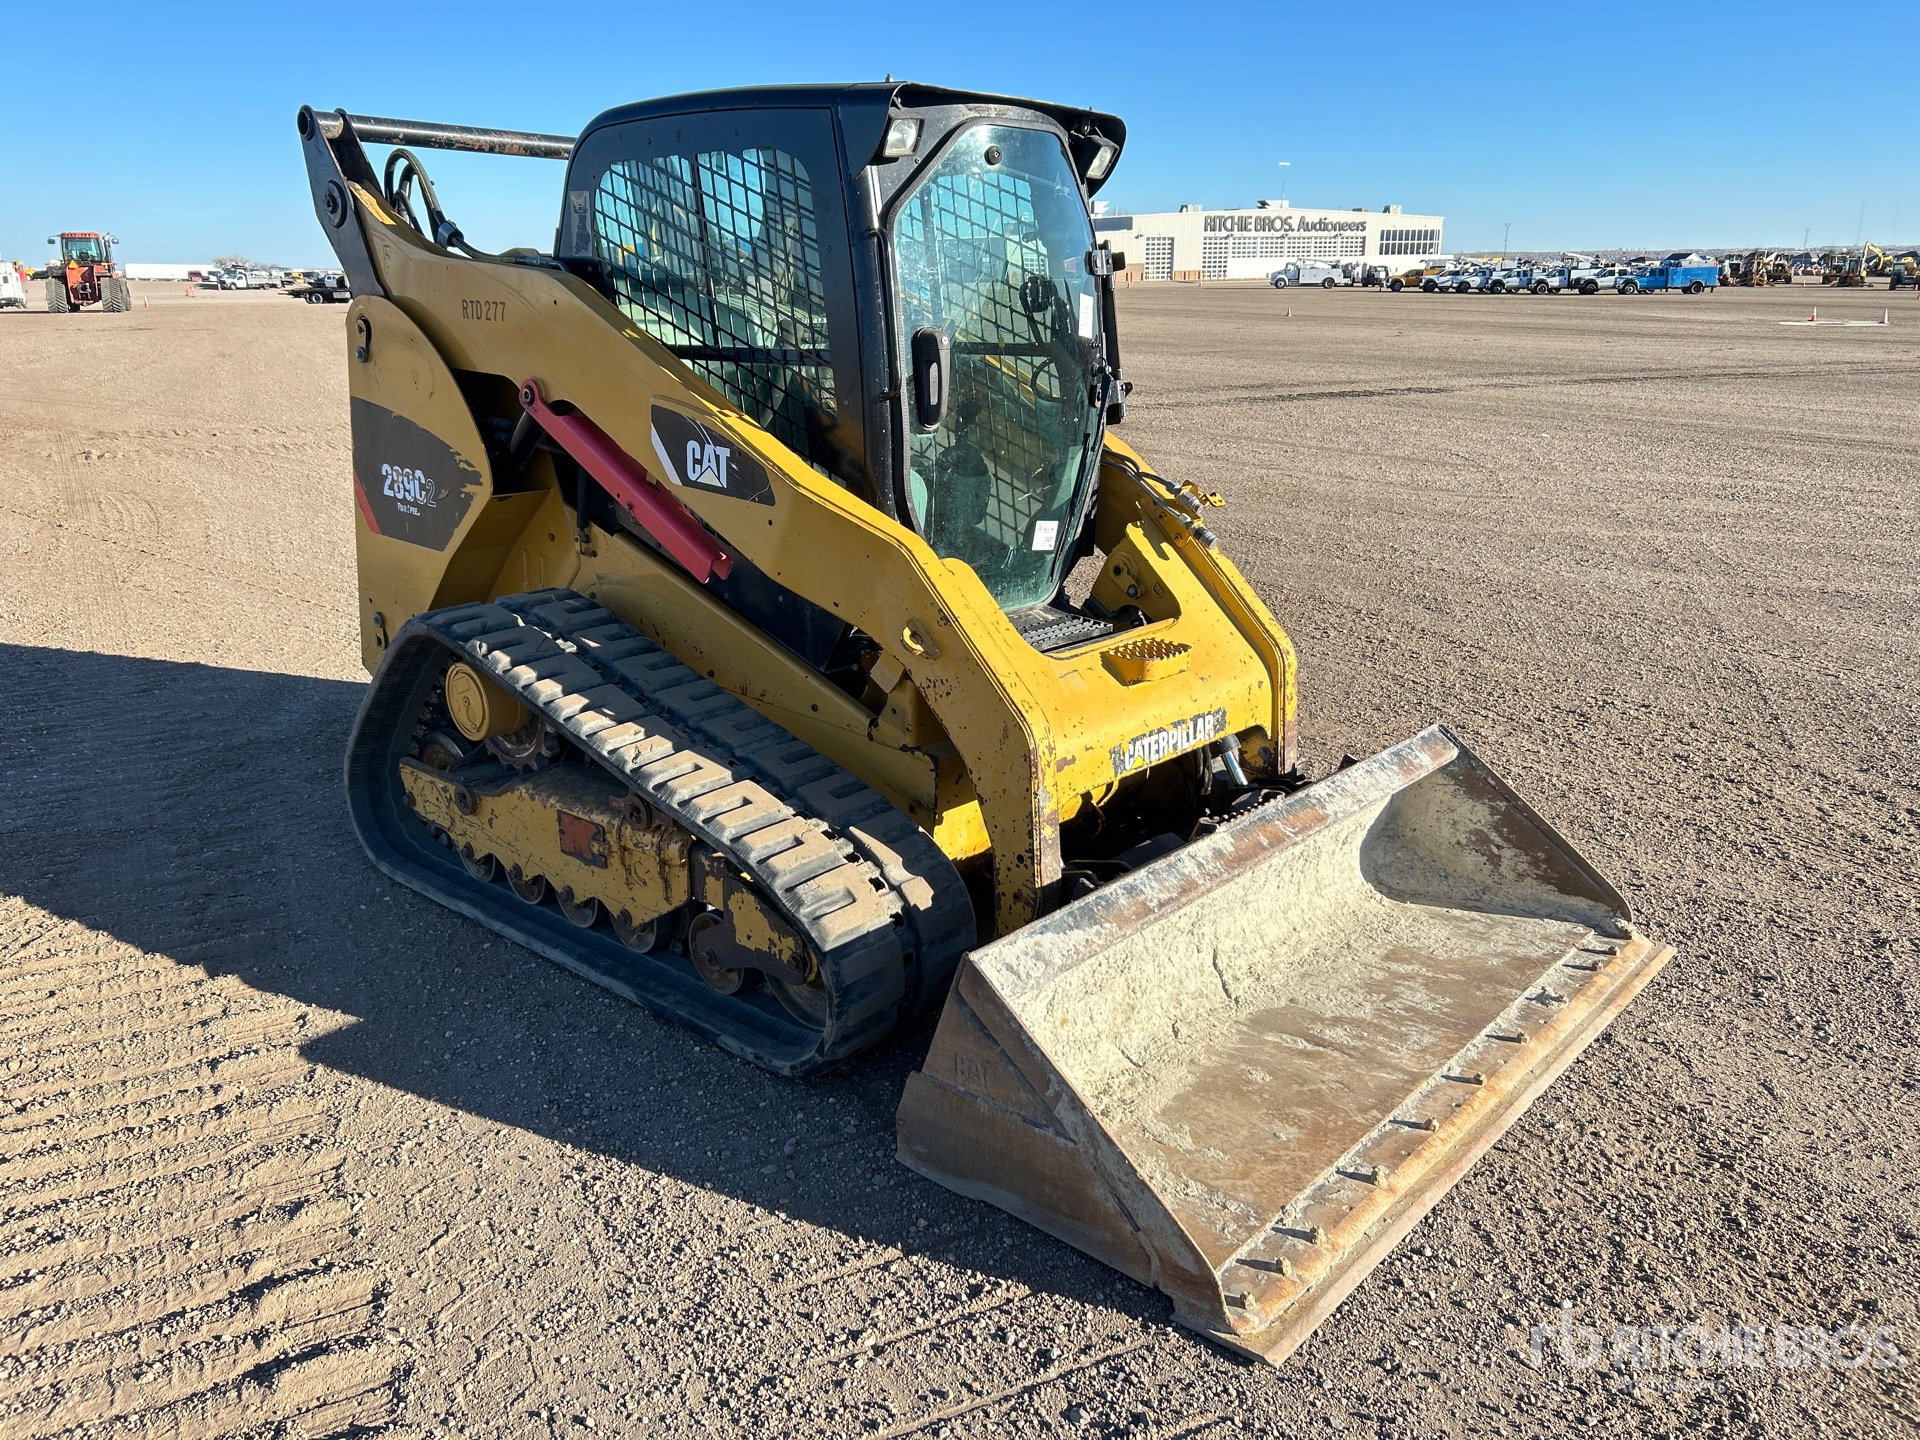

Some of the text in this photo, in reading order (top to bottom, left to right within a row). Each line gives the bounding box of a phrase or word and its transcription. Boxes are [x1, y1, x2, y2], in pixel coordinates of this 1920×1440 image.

[1203, 215, 1367, 233] RITCHIE BROS. Auctioneers
[462, 299, 506, 322] RTD 277
[686, 440, 730, 488] CAT
[1125, 714, 1215, 770] CATERPILLAR
